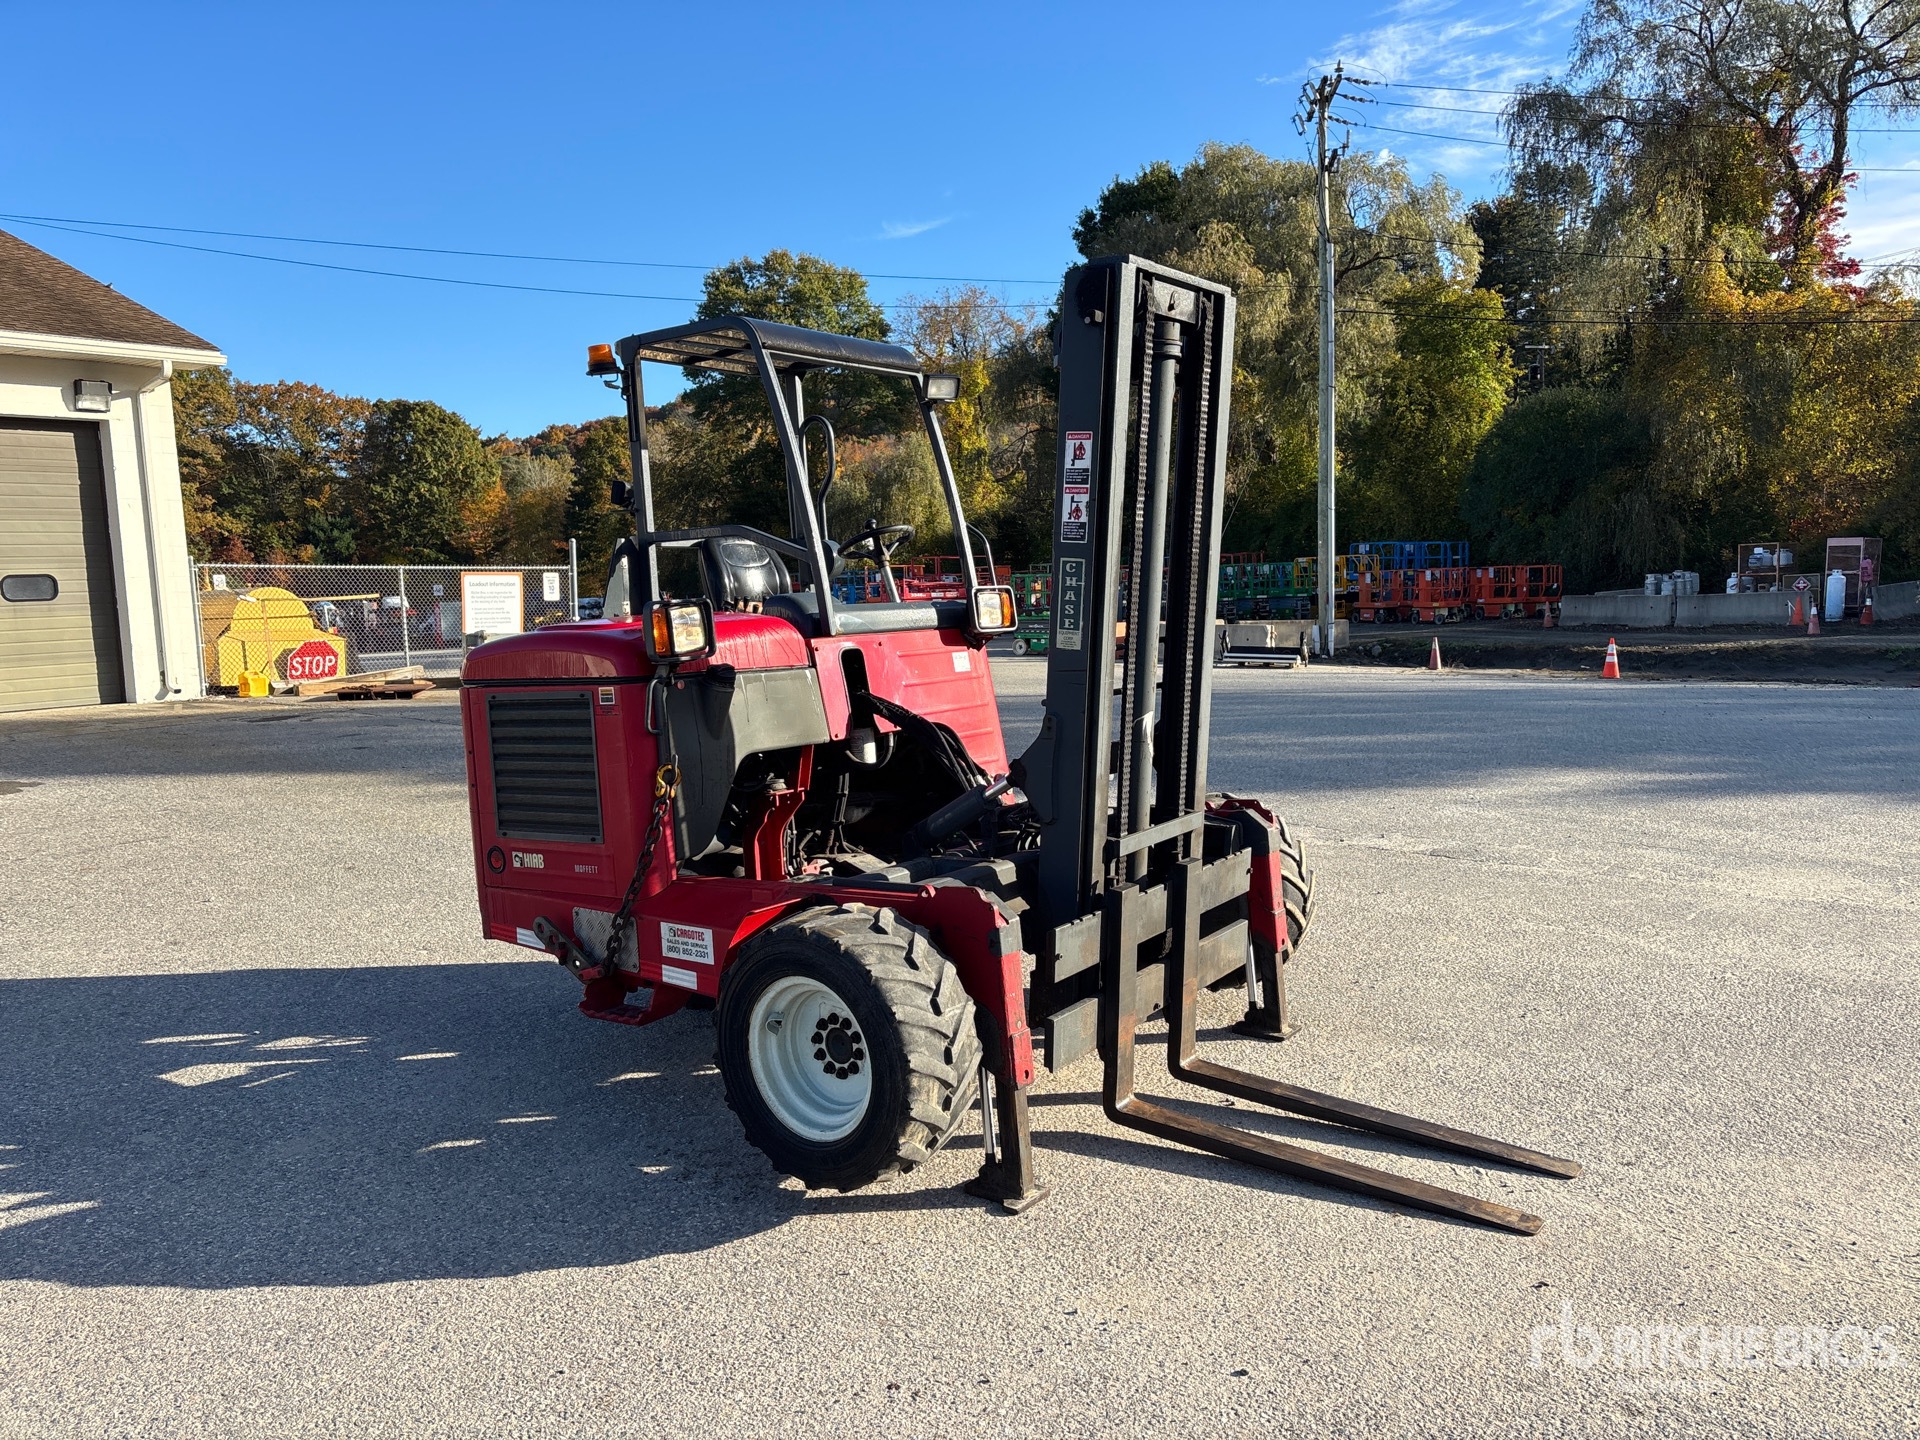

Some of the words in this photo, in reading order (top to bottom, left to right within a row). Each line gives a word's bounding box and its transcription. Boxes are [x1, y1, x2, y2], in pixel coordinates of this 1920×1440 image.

[1063, 562, 1078, 629] CHASE
[291, 655, 336, 676] STOP
[523, 852, 545, 869] HIAB
[574, 864, 598, 874] MOFFETT
[676, 928, 705, 941] CARGOTEC
[666, 944, 681, 955] (800)
[681, 947, 709, 959] 852-2331
[690, 942, 709, 950] SERVICE
